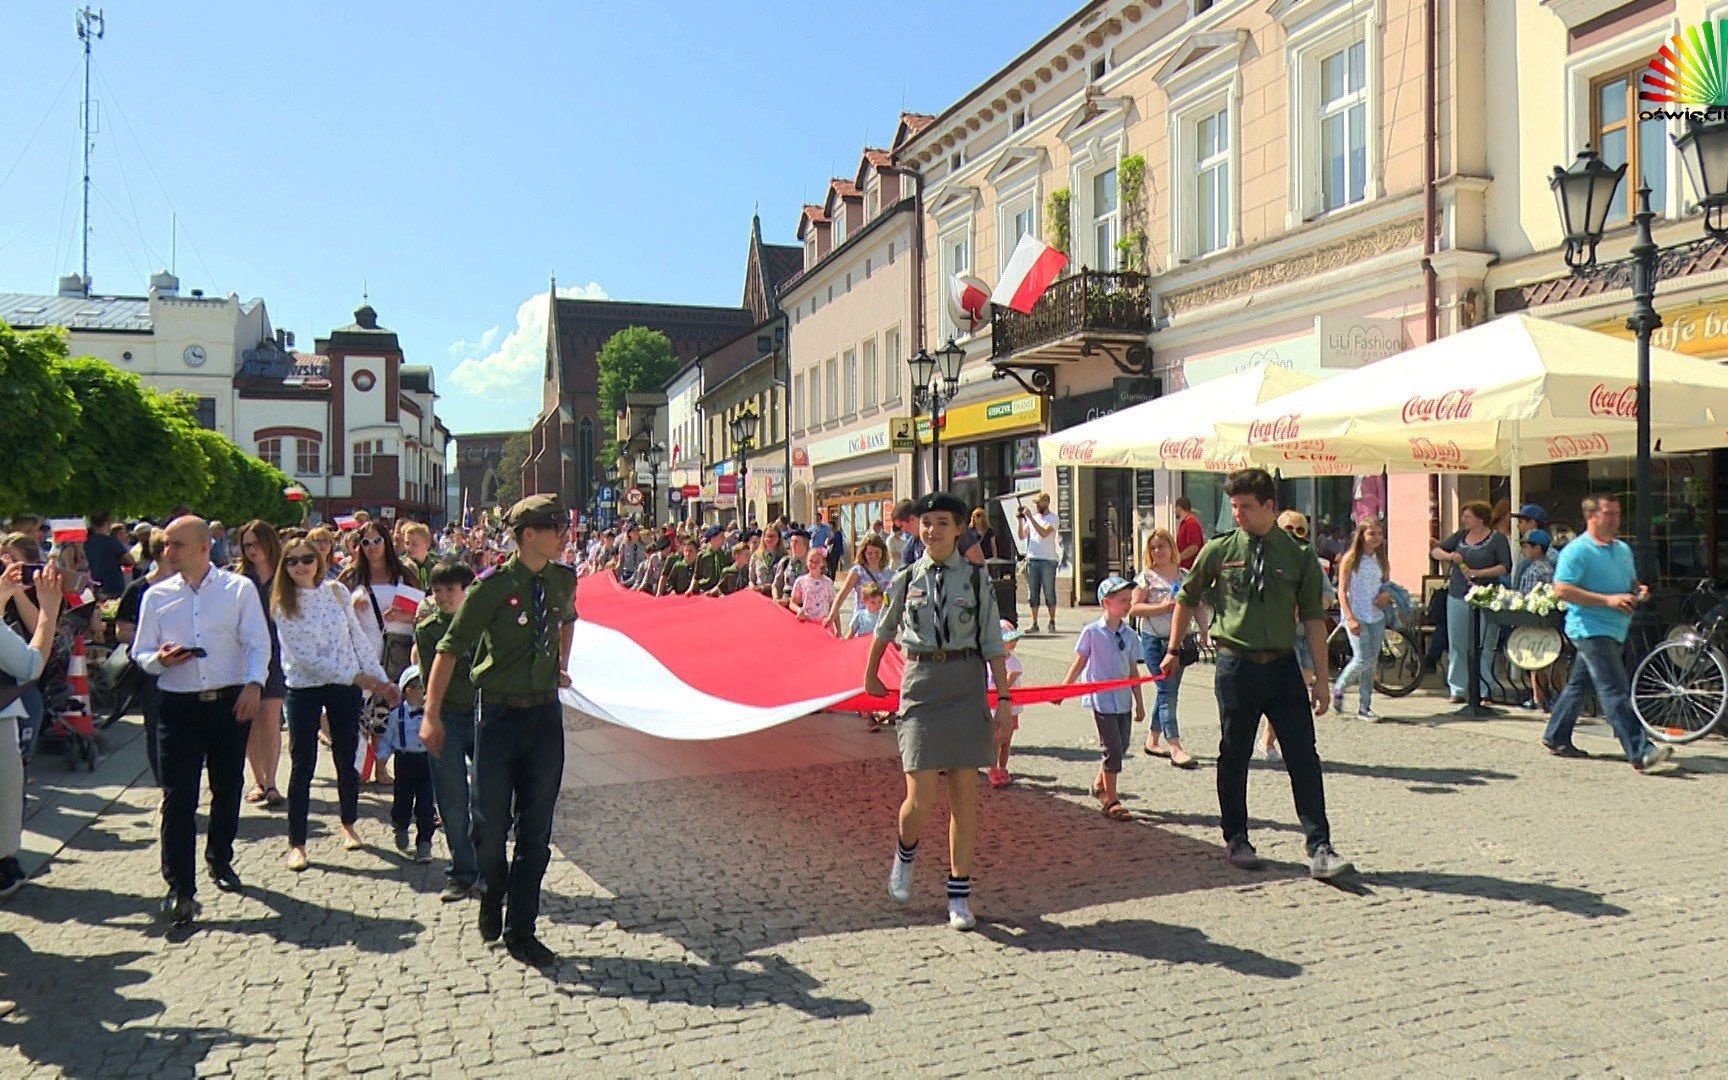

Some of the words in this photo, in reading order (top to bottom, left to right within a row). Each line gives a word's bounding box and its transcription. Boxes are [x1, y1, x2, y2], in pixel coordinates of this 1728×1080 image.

[1354, 335, 1401, 350] Fashion
[1651, 315, 1697, 351] afe
[1402, 388, 1476, 424] Coca-Cola
[1247, 414, 1301, 445] Coca-Cola
[1060, 439, 1097, 460] Coca-Cola
[1160, 437, 1206, 459] Coca-Cola
